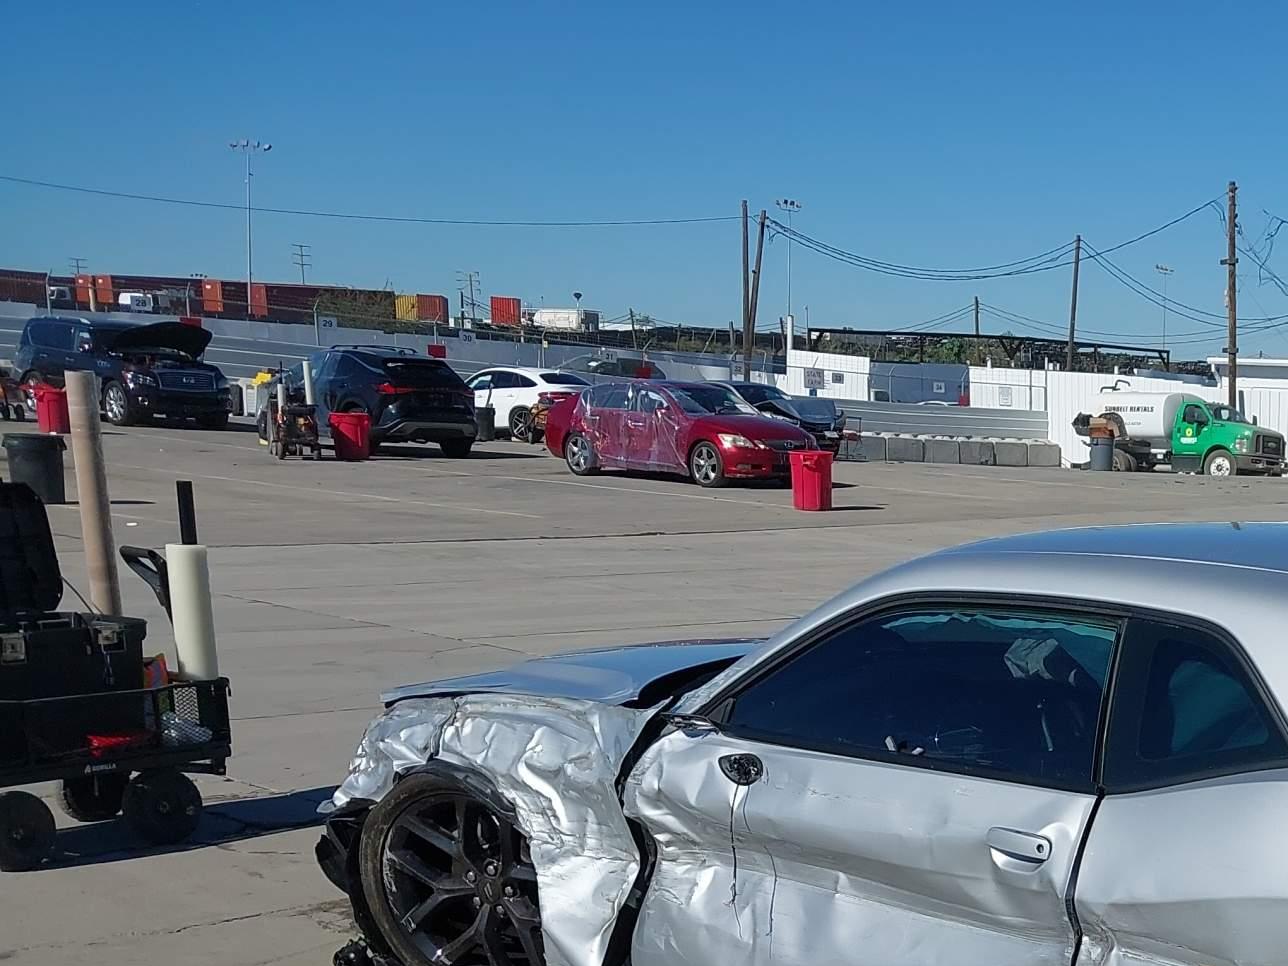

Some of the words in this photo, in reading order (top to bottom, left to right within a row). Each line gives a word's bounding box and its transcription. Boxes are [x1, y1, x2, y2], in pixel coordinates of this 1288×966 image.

[135, 299, 147, 307] 28
[322, 319, 333, 328] 29
[462, 334, 472, 343] 30
[1105, 405, 1128, 413] SUNBELT
